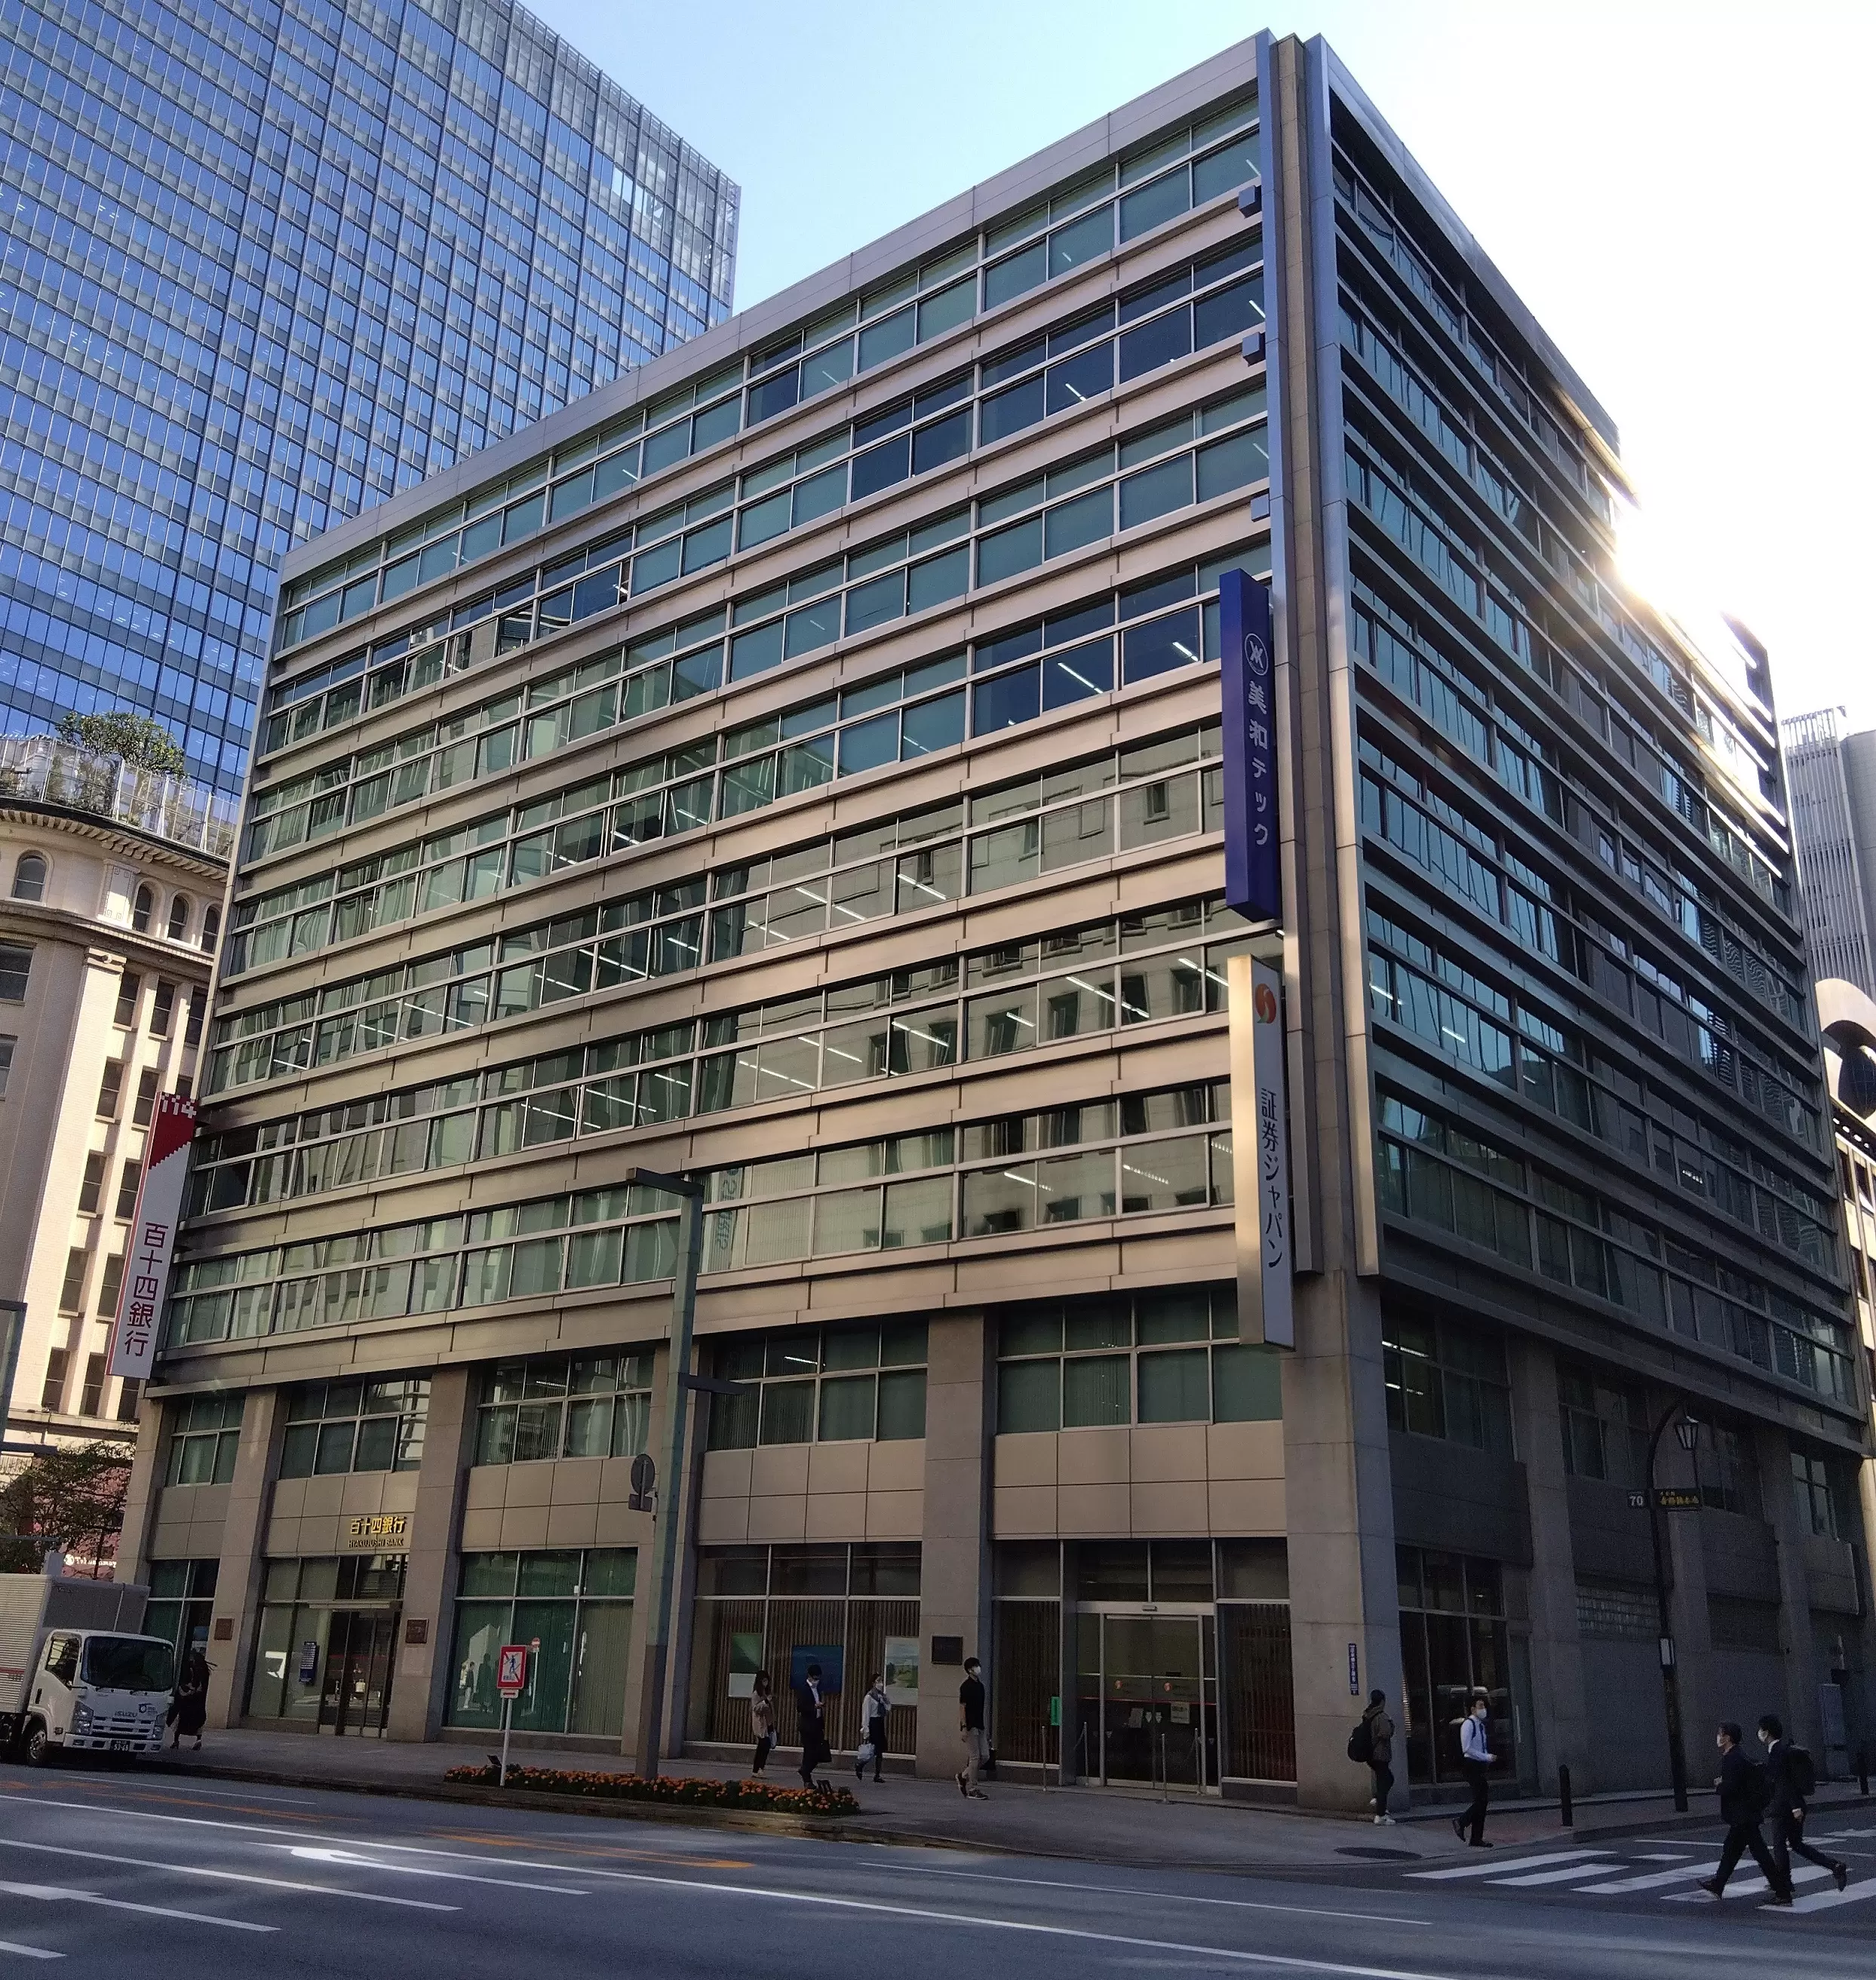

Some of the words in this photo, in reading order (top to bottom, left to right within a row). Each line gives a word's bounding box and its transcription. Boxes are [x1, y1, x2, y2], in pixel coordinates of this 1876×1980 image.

[1248, 680, 1269, 846] 美和テック
[1261, 1088, 1283, 1269] 証券ジャパン
[124, 1222, 169, 1357] 百十四銀行
[350, 1516, 405, 1535] 百十四銀行
[1629, 1495, 1644, 1506] 70
[348, 1539, 385, 1549] HYAKUJUSHI
[386, 1538, 404, 1547] BANK
